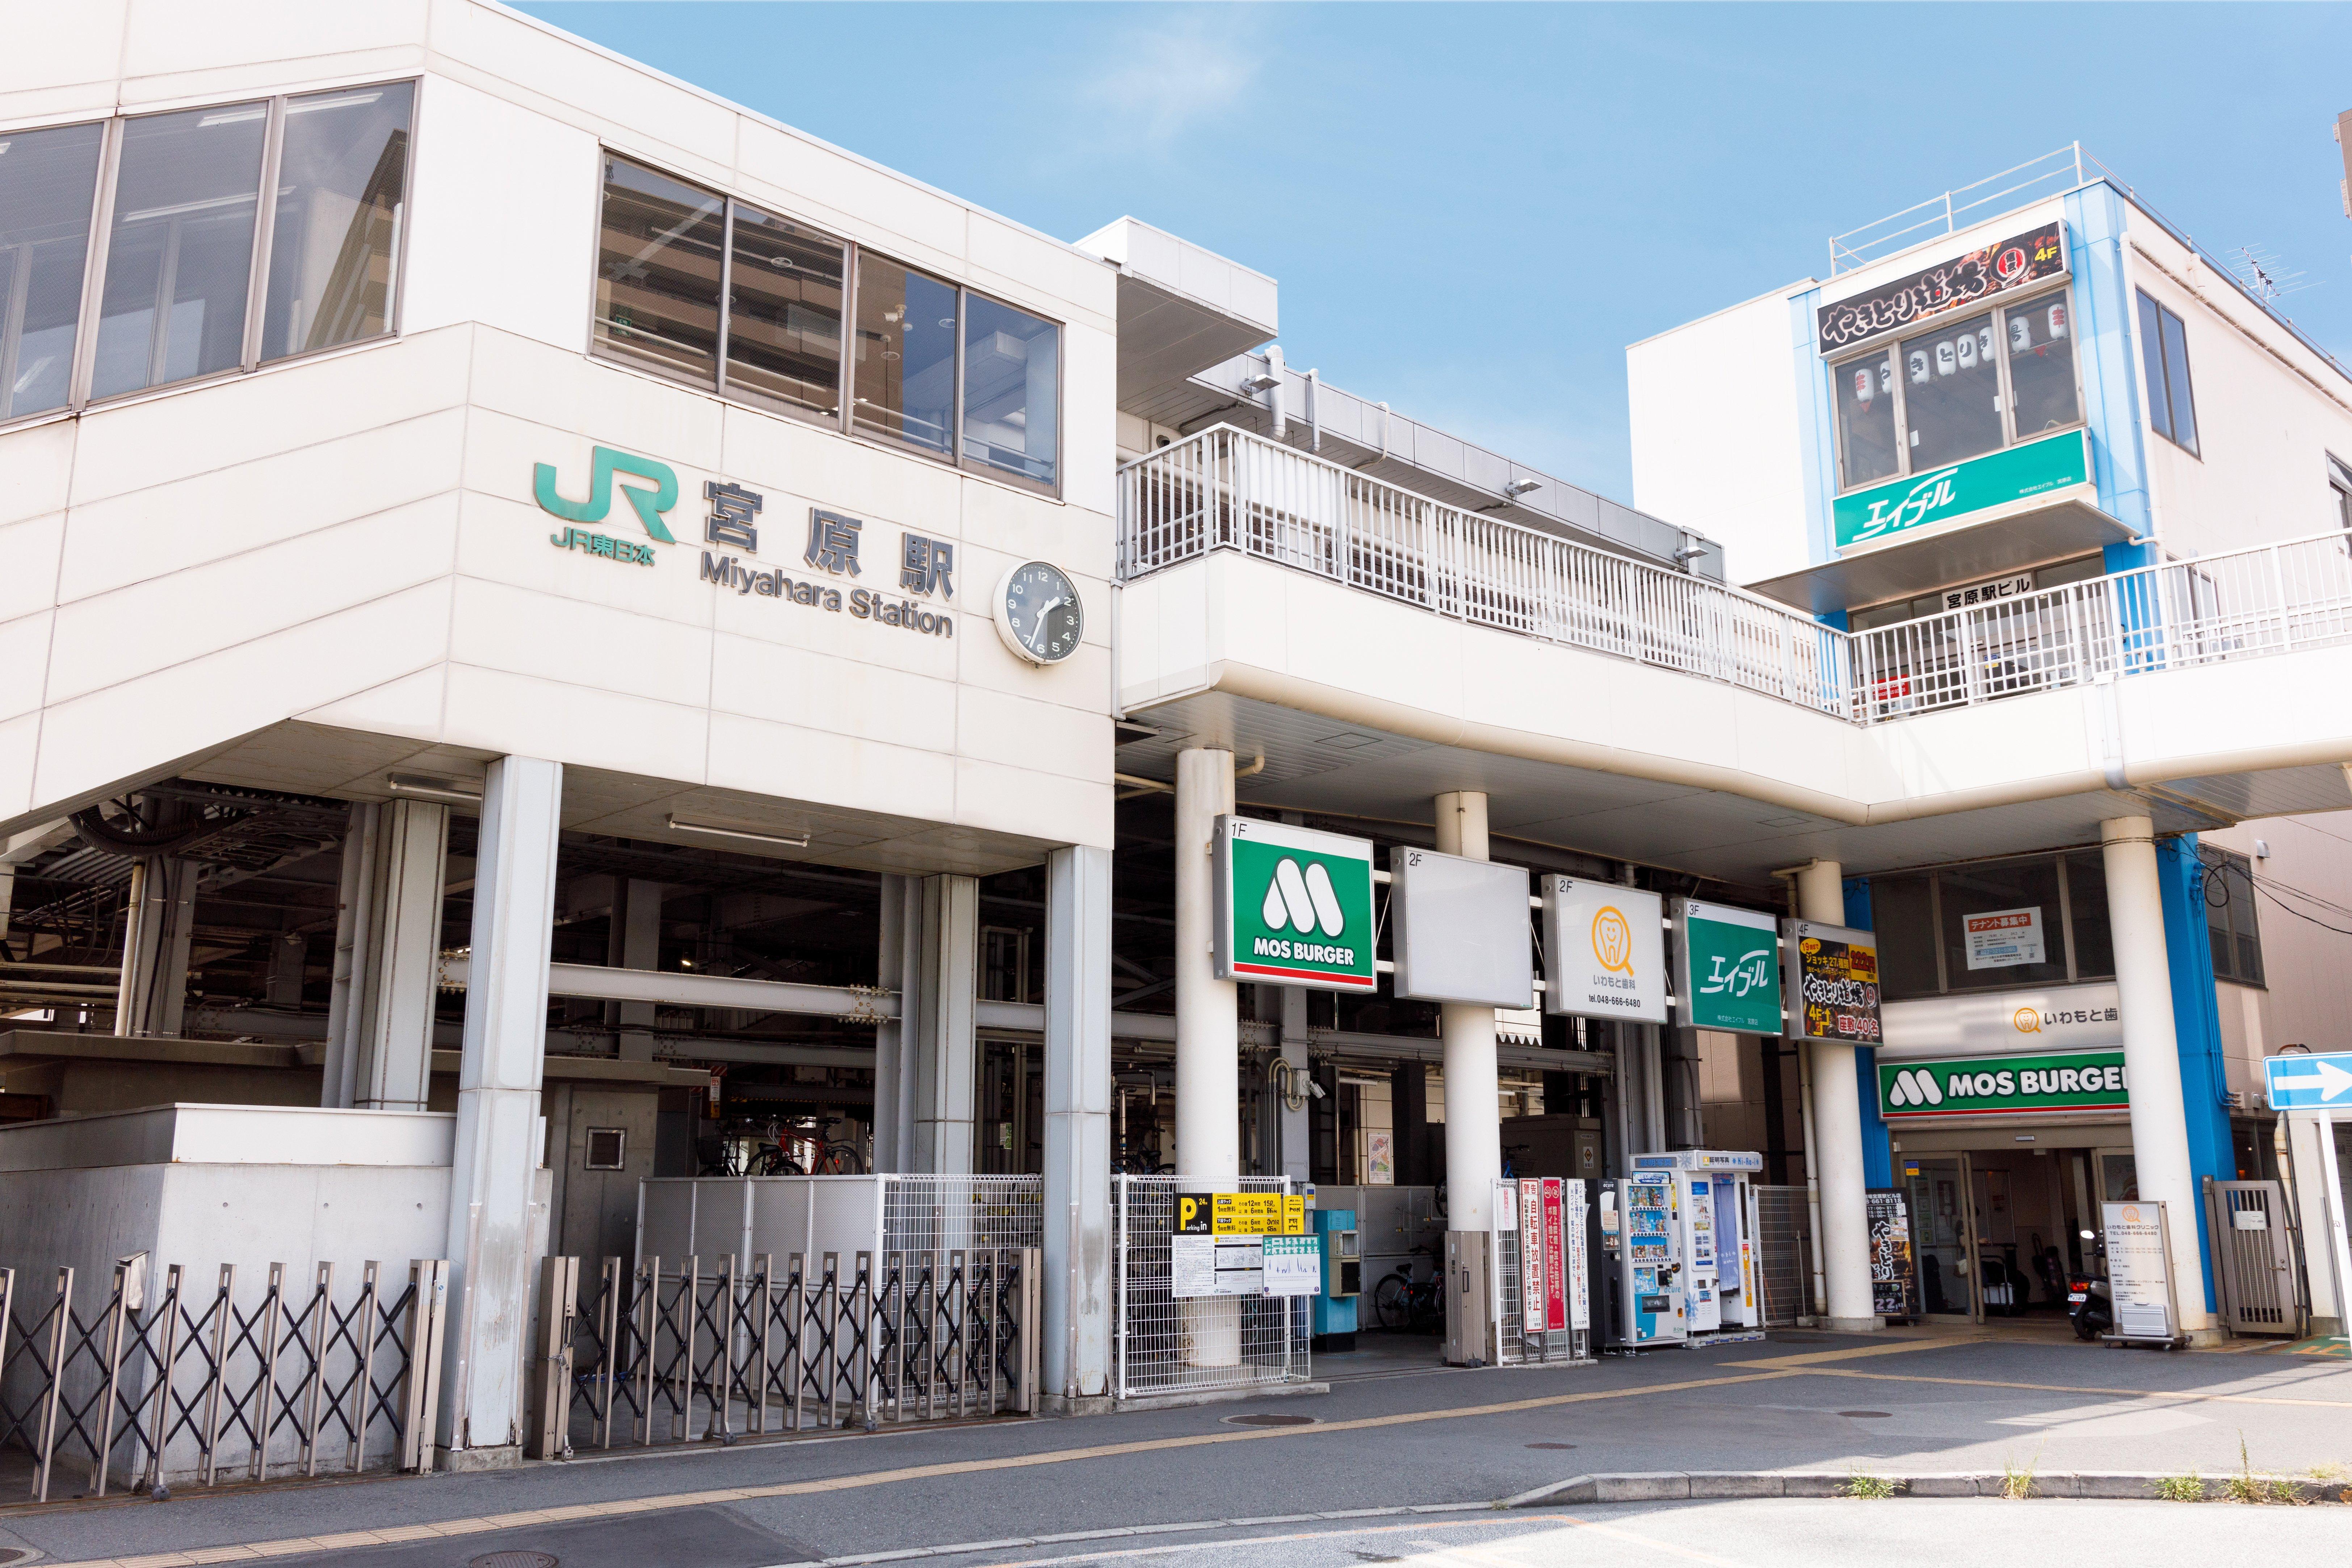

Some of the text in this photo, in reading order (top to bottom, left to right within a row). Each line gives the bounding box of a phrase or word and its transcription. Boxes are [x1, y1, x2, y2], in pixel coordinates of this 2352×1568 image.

[2034, 246, 2058, 262] 4F
[1822, 259, 1987, 344] やきとり道場
[534, 445, 678, 543] JR
[1853, 468, 1958, 541] エイブル
[550, 527, 656, 567] JR東日本
[703, 479, 954, 601] 宮原駅
[1023, 572, 1032, 583] 11
[1038, 571, 1048, 582] 12
[700, 551, 953, 639] Miyahara Station
[1012, 584, 1023, 594] 10
[1947, 577, 2030, 609] 宮原駅ビル
[1008, 599, 1016, 609] 9
[1064, 597, 1071, 606] 2
[1012, 618, 1020, 627] 8
[1066, 615, 1074, 625] 3
[1024, 634, 1031, 644] 7
[1062, 632, 1071, 641] 4
[1037, 644, 1045, 653] 6
[1051, 642, 1060, 652] 5
[1231, 823, 1248, 837] 1F
[1409, 853, 1422, 867] 2F
[1559, 880, 1573, 893] 2F
[1689, 904, 1700, 916] 3F
[1799, 924, 1808, 935] 4F
[1971, 916, 2027, 930] テナント募集中
[1254, 938, 1354, 966] MOS BURGER
[1700, 950, 1769, 997] エイブル
[1593, 974, 1635, 991] いわもと歯科
[1803, 973, 1864, 1008] やきとり道場
[1589, 993, 1641, 1009] tel.048-666-6480
[1809, 1004, 1822, 1021] 4F
[1838, 1015, 1879, 1037] 座敷40名
[1949, 1070, 2015, 1097] MOS
[1524, 1184, 1536, 1194] 警告
[1530, 1199, 1540, 1311] 自転車放置禁止
